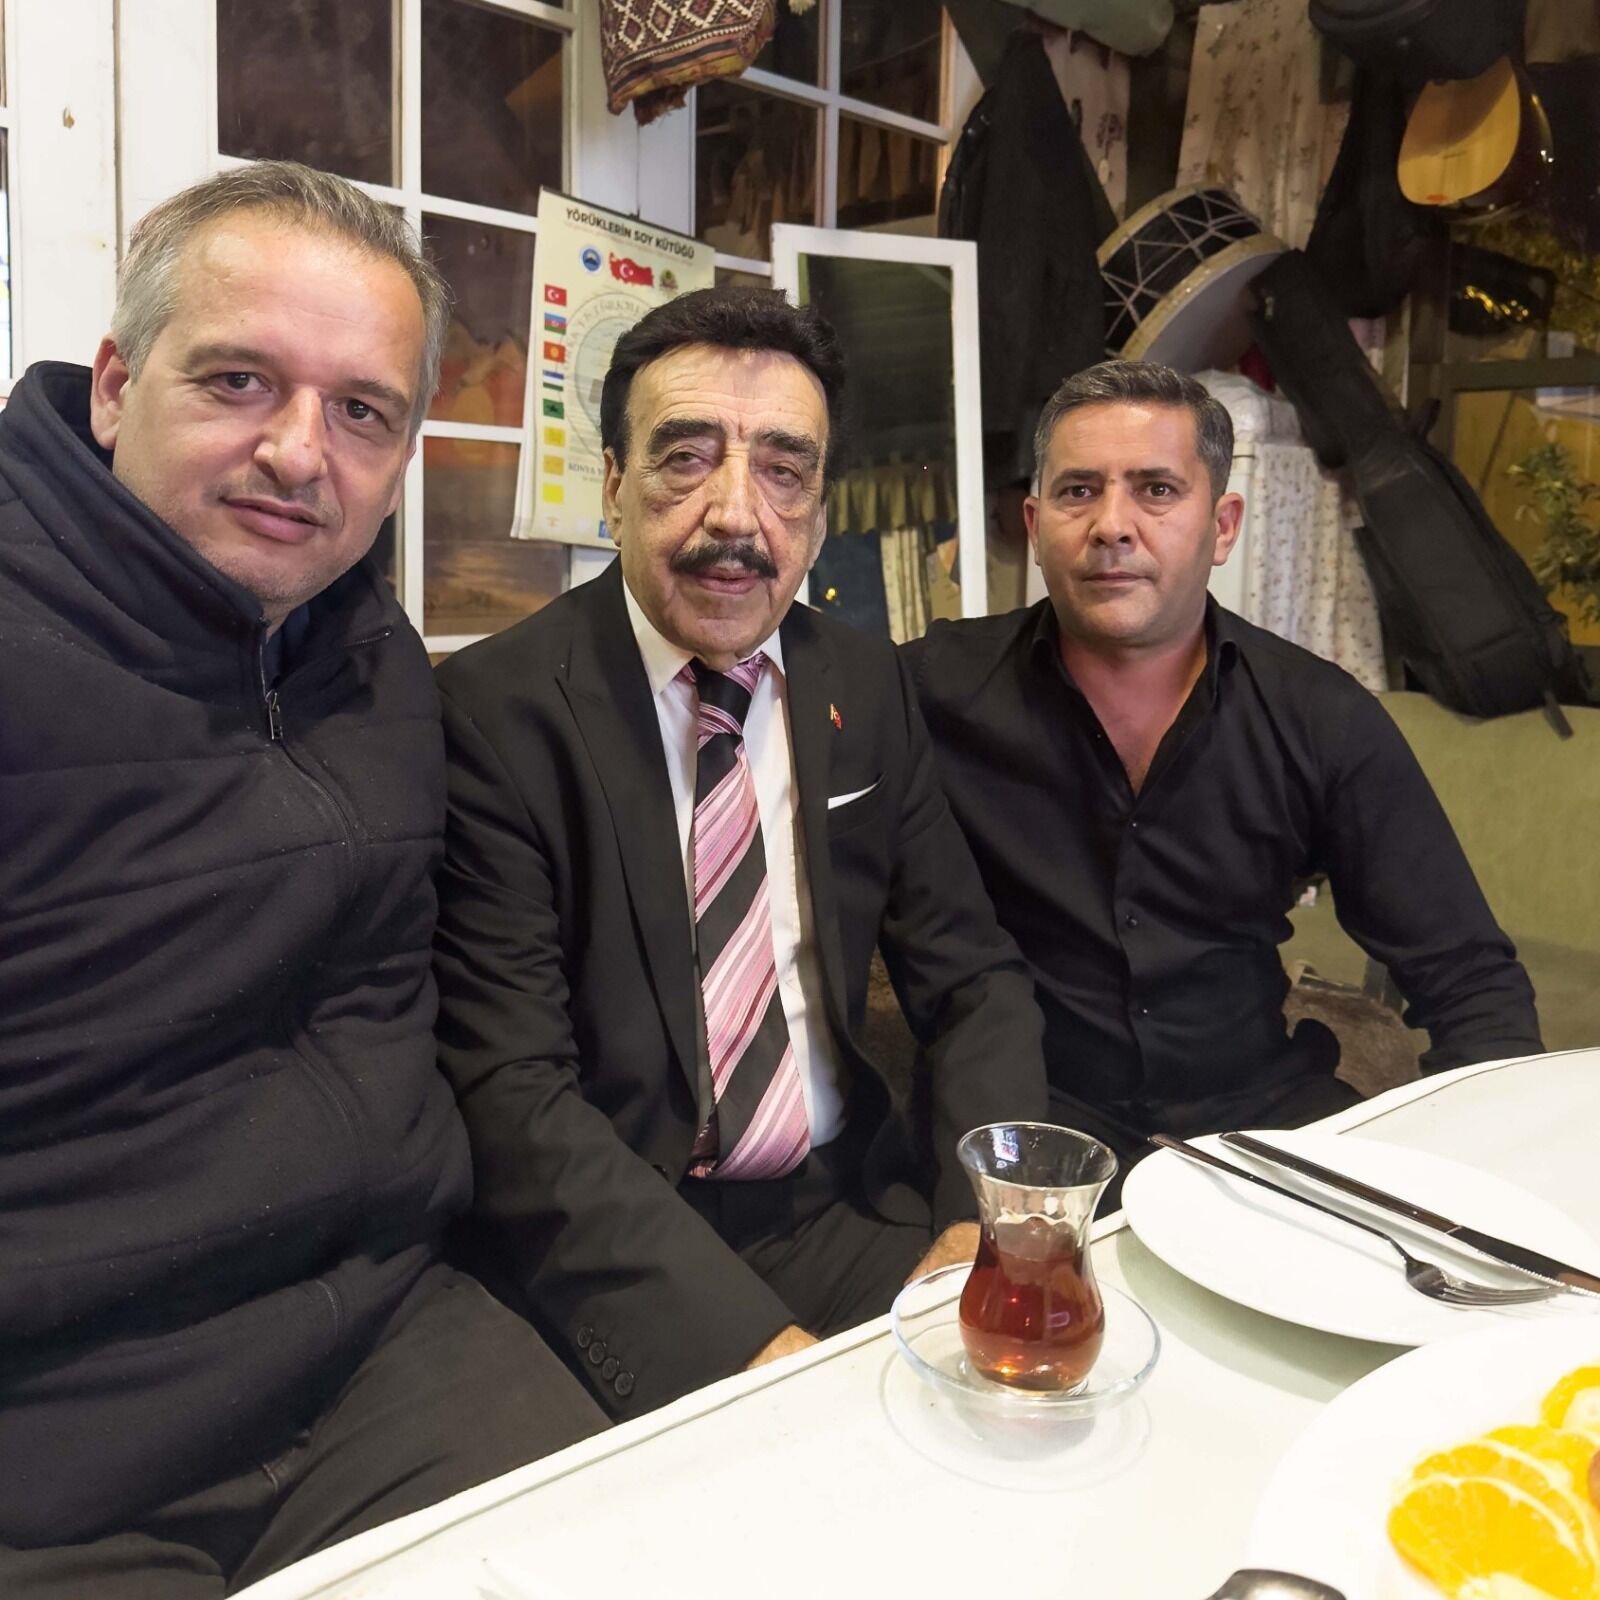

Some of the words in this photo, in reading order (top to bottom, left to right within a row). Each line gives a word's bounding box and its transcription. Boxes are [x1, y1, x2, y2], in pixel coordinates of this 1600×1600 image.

[566, 207, 632, 239] YÖRÜKLERİN
[634, 231, 654, 247] SOY
[655, 237, 695, 260] KÜTÜĞÜ
